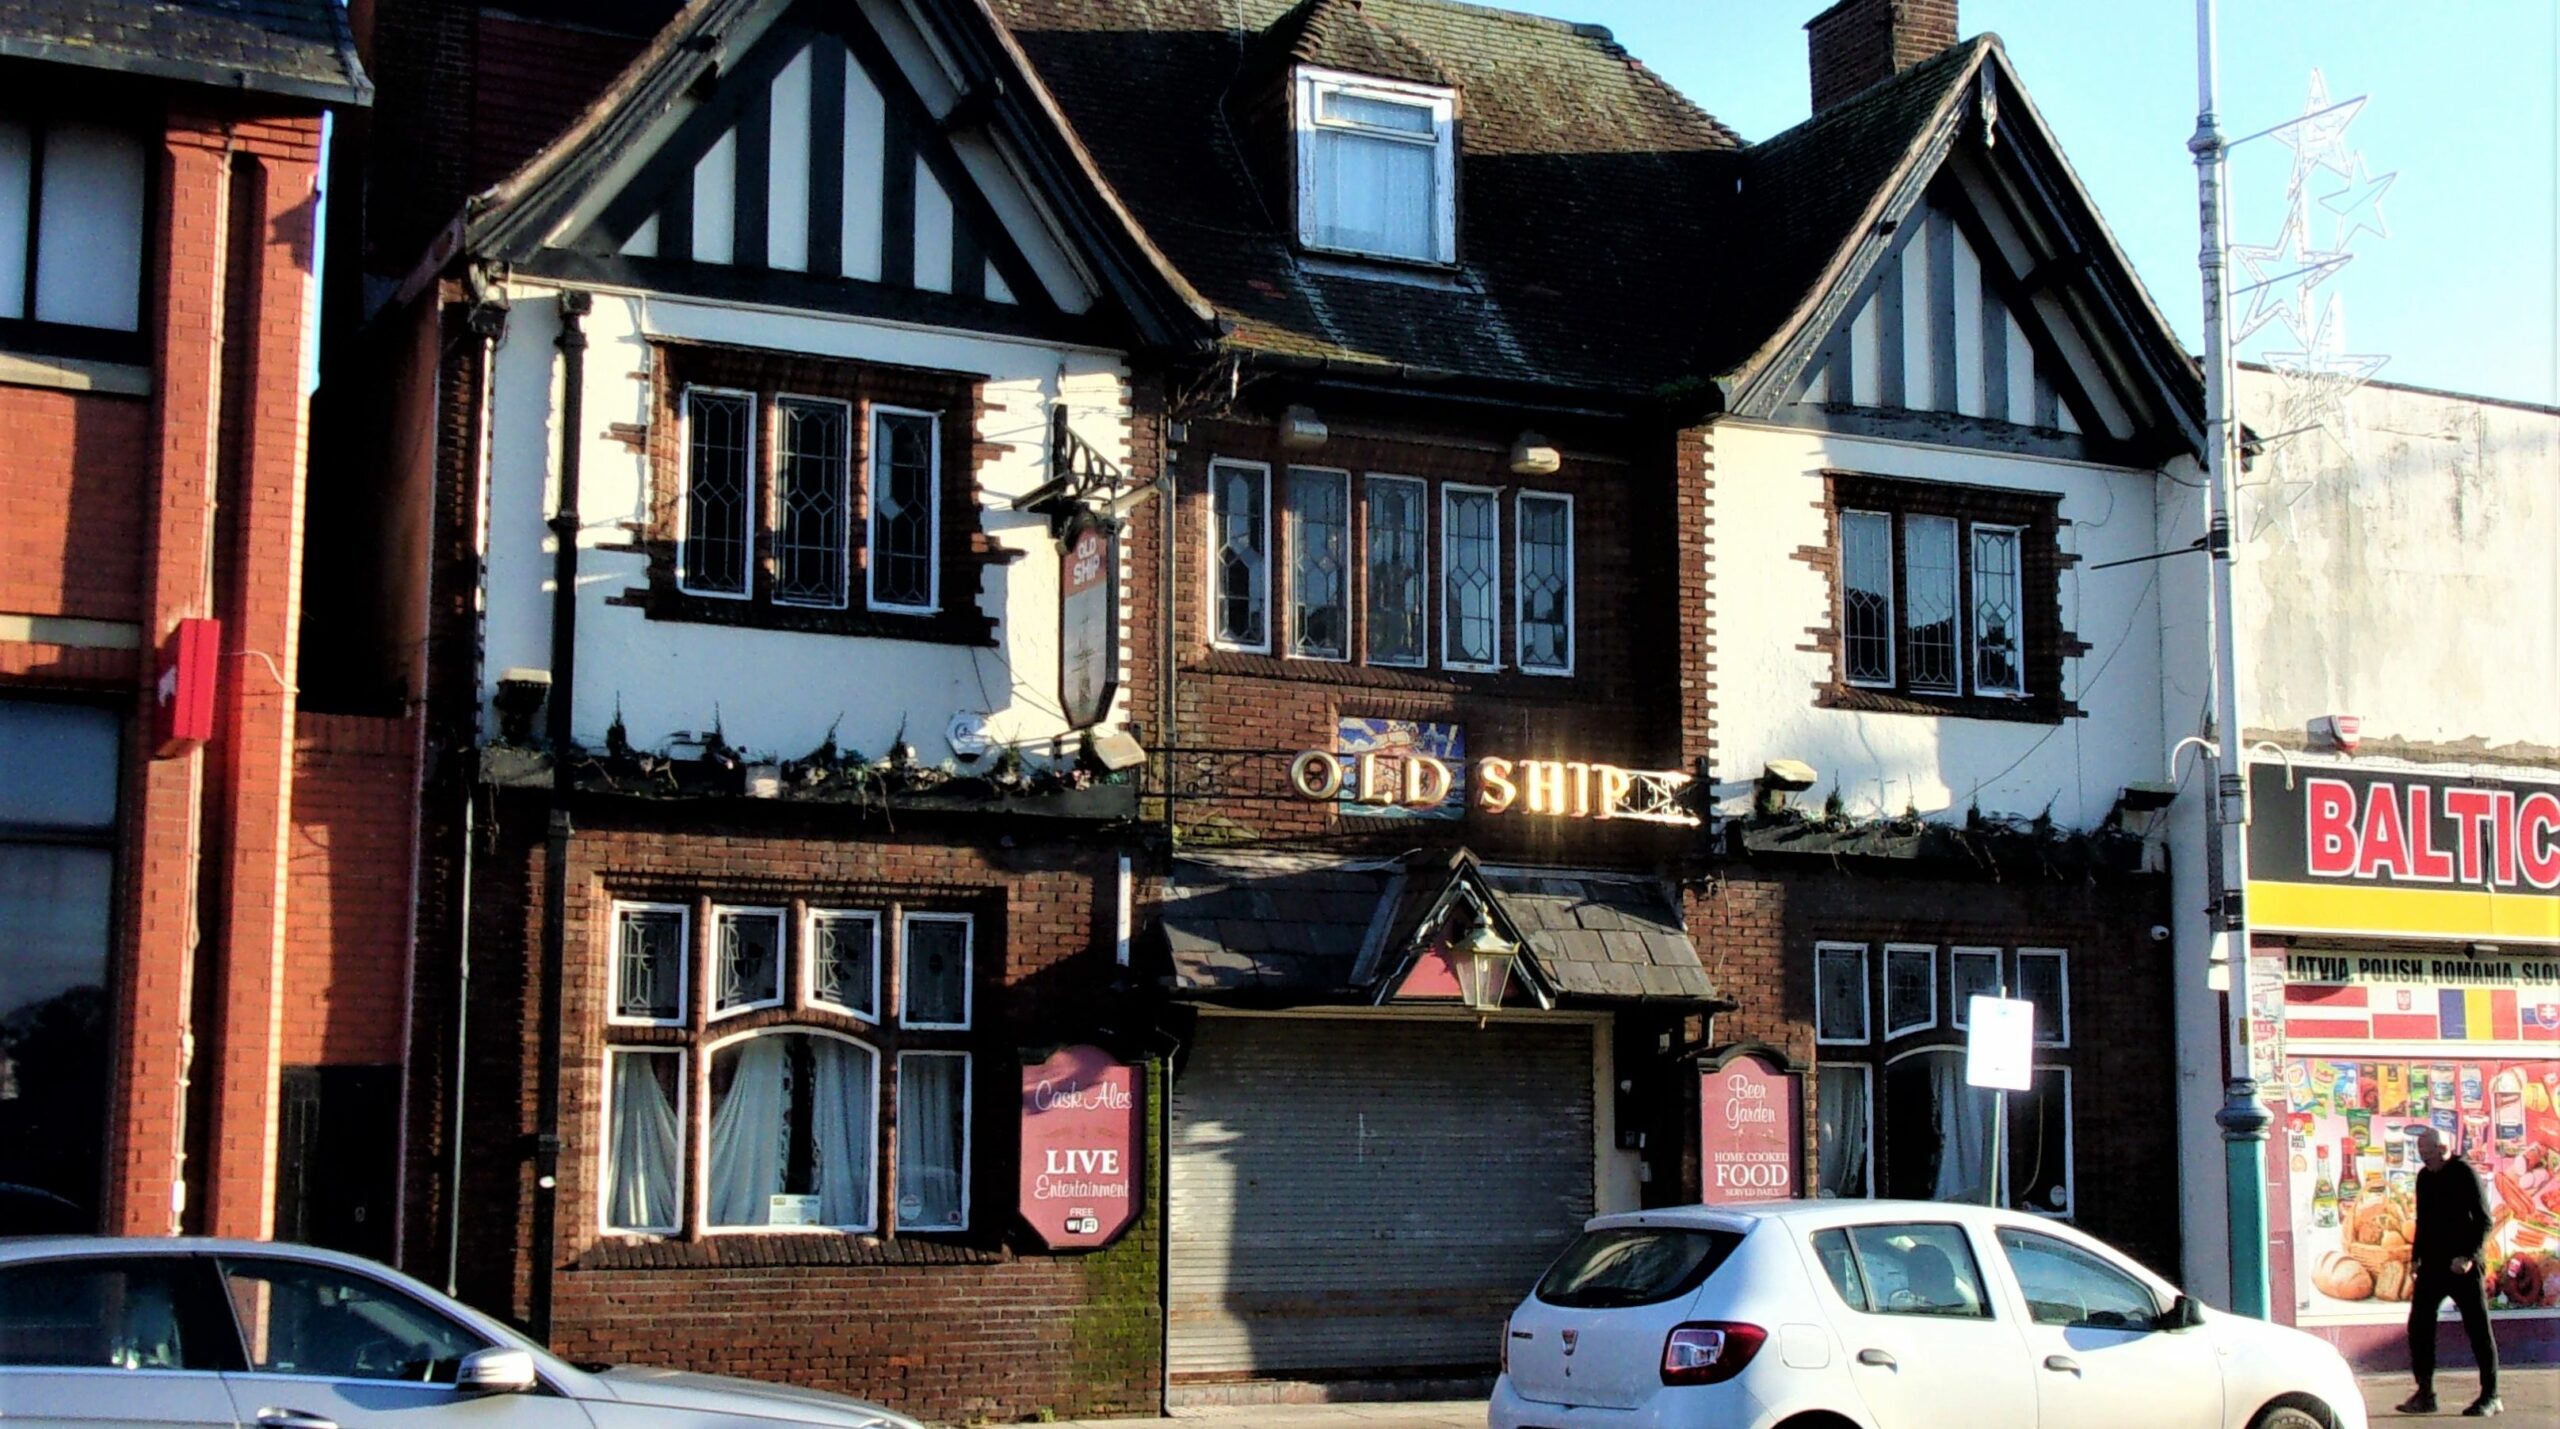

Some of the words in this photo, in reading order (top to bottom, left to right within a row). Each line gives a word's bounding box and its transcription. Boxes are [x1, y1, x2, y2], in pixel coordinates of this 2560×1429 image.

[1078, 538, 1097, 560] OLD
[1073, 554, 1100, 585] SHIP
[1291, 750, 1452, 806] OLD
[1479, 756, 1631, 819] SHIP
[2306, 778, 2560, 889] BALTIC
[1035, 1080, 1083, 1109] Cask
[1084, 1082, 1132, 1110] Ales
[1728, 1074, 1766, 1100] Beer
[1726, 1098, 1776, 1129] Garden
[1045, 1149, 1120, 1175] LIVE
[1714, 1152, 1745, 1162] HOME
[1747, 1152, 1789, 1162] COOKED
[1034, 1174, 1129, 1199] Entertainment
[1716, 1164, 1788, 1187] FOOD
[1725, 1188, 1756, 1196] SERVED
[1757, 1188, 1779, 1196] DAILY
[1069, 1208, 1094, 1217] FREE
